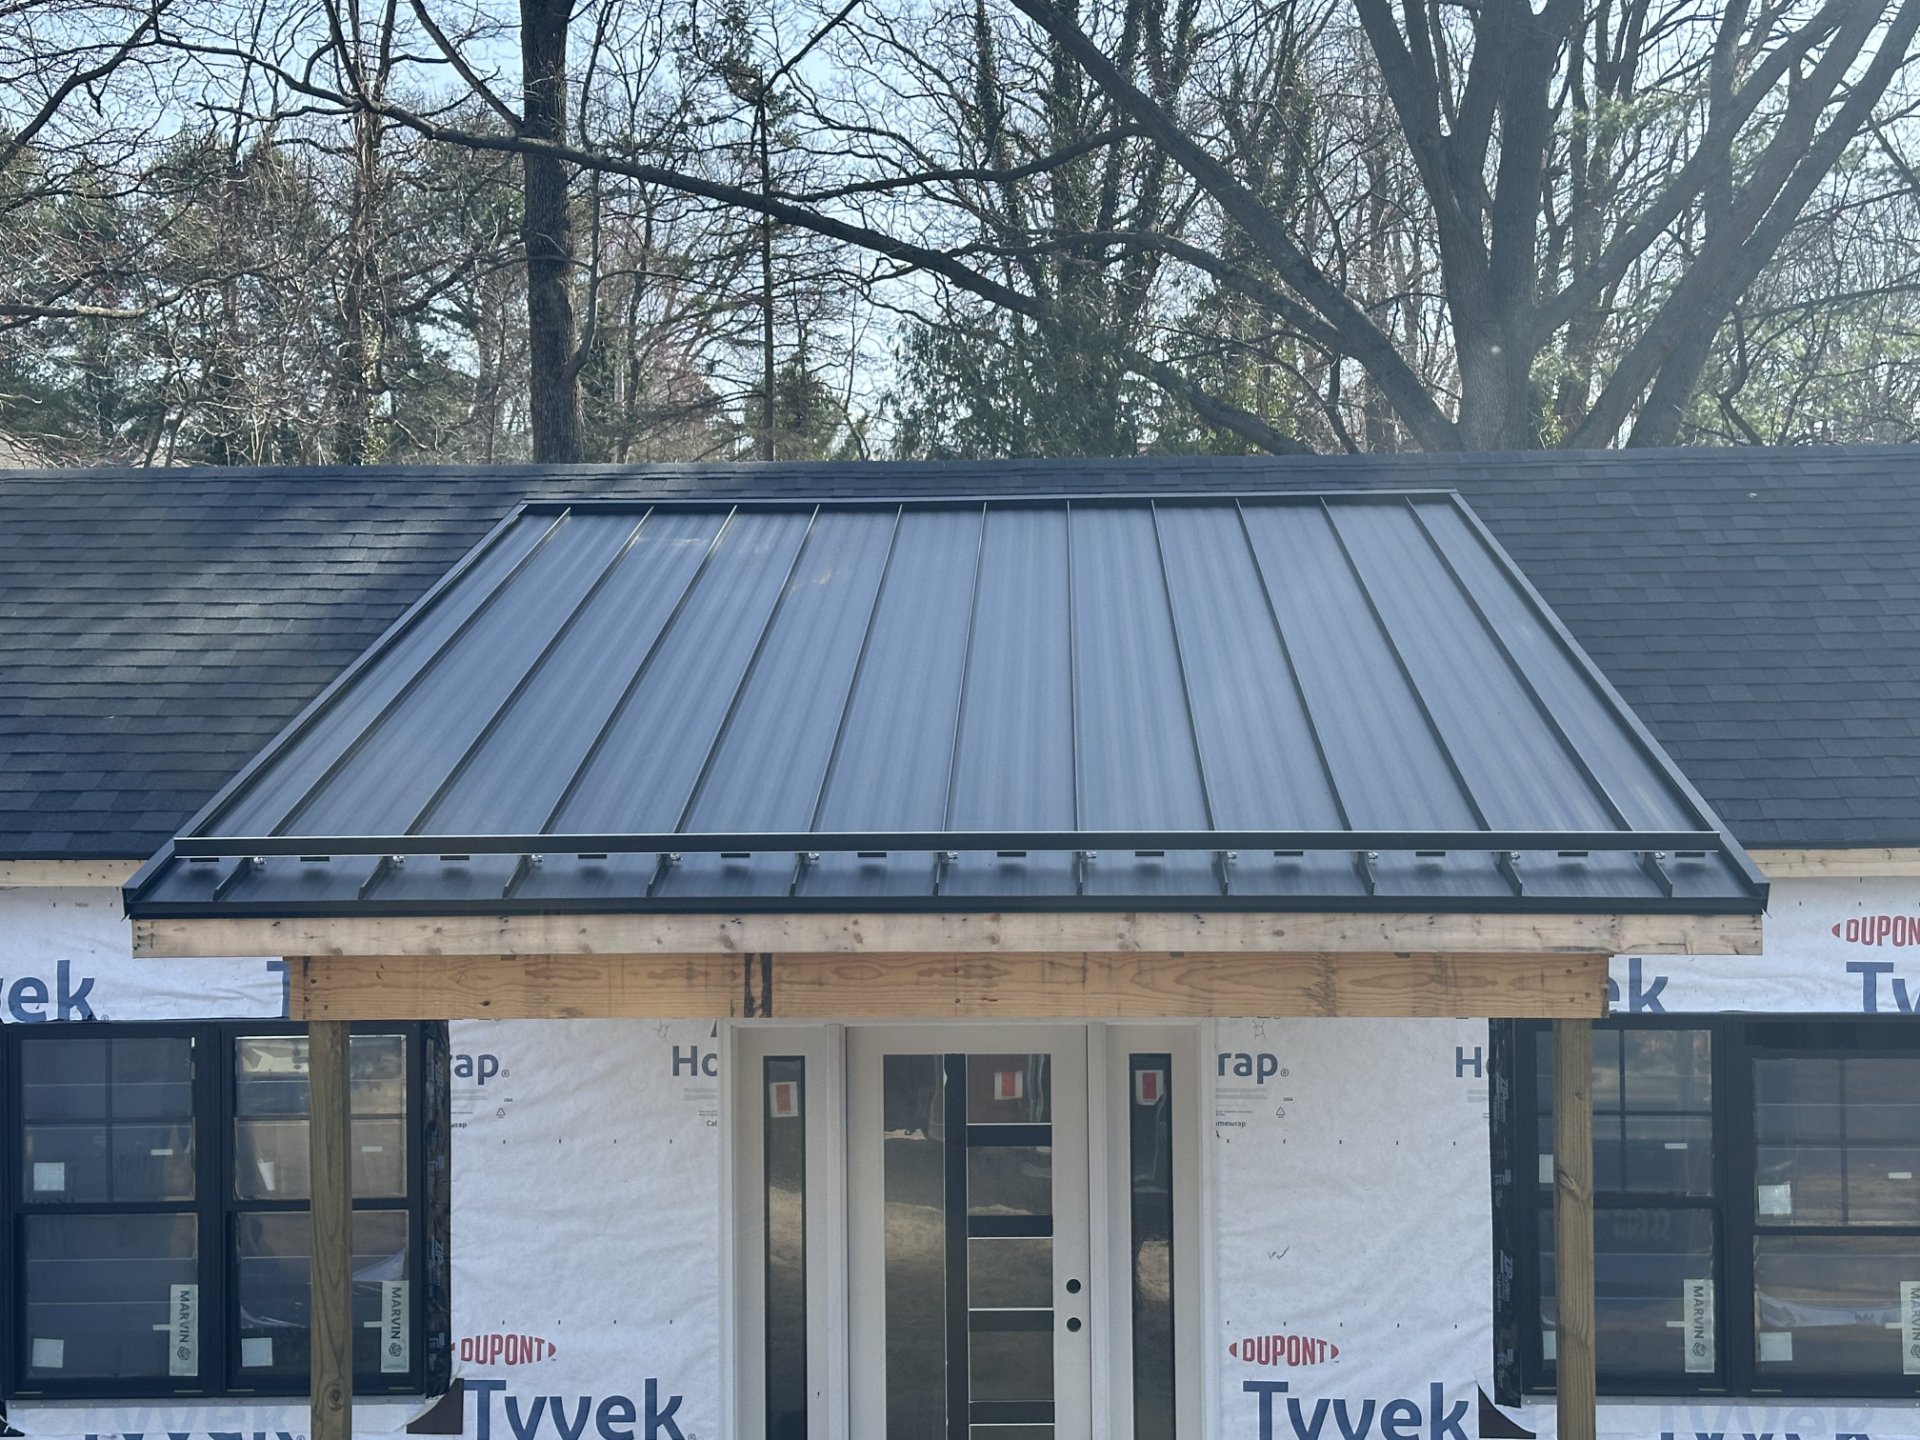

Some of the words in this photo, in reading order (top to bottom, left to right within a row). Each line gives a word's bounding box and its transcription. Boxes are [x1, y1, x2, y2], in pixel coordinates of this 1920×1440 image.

[0, 959, 97, 1023] ek
[1608, 957, 1668, 1013] k
[450, 1054, 499, 1085] ap
[179, 1290, 190, 1343] MARVIN
[391, 1286, 402, 1339] MARVIN
[1693, 1285, 1704, 1339] MARVIN
[460, 1333, 545, 1366] DUPONT
[1242, 1335, 1328, 1367] DUPONT
